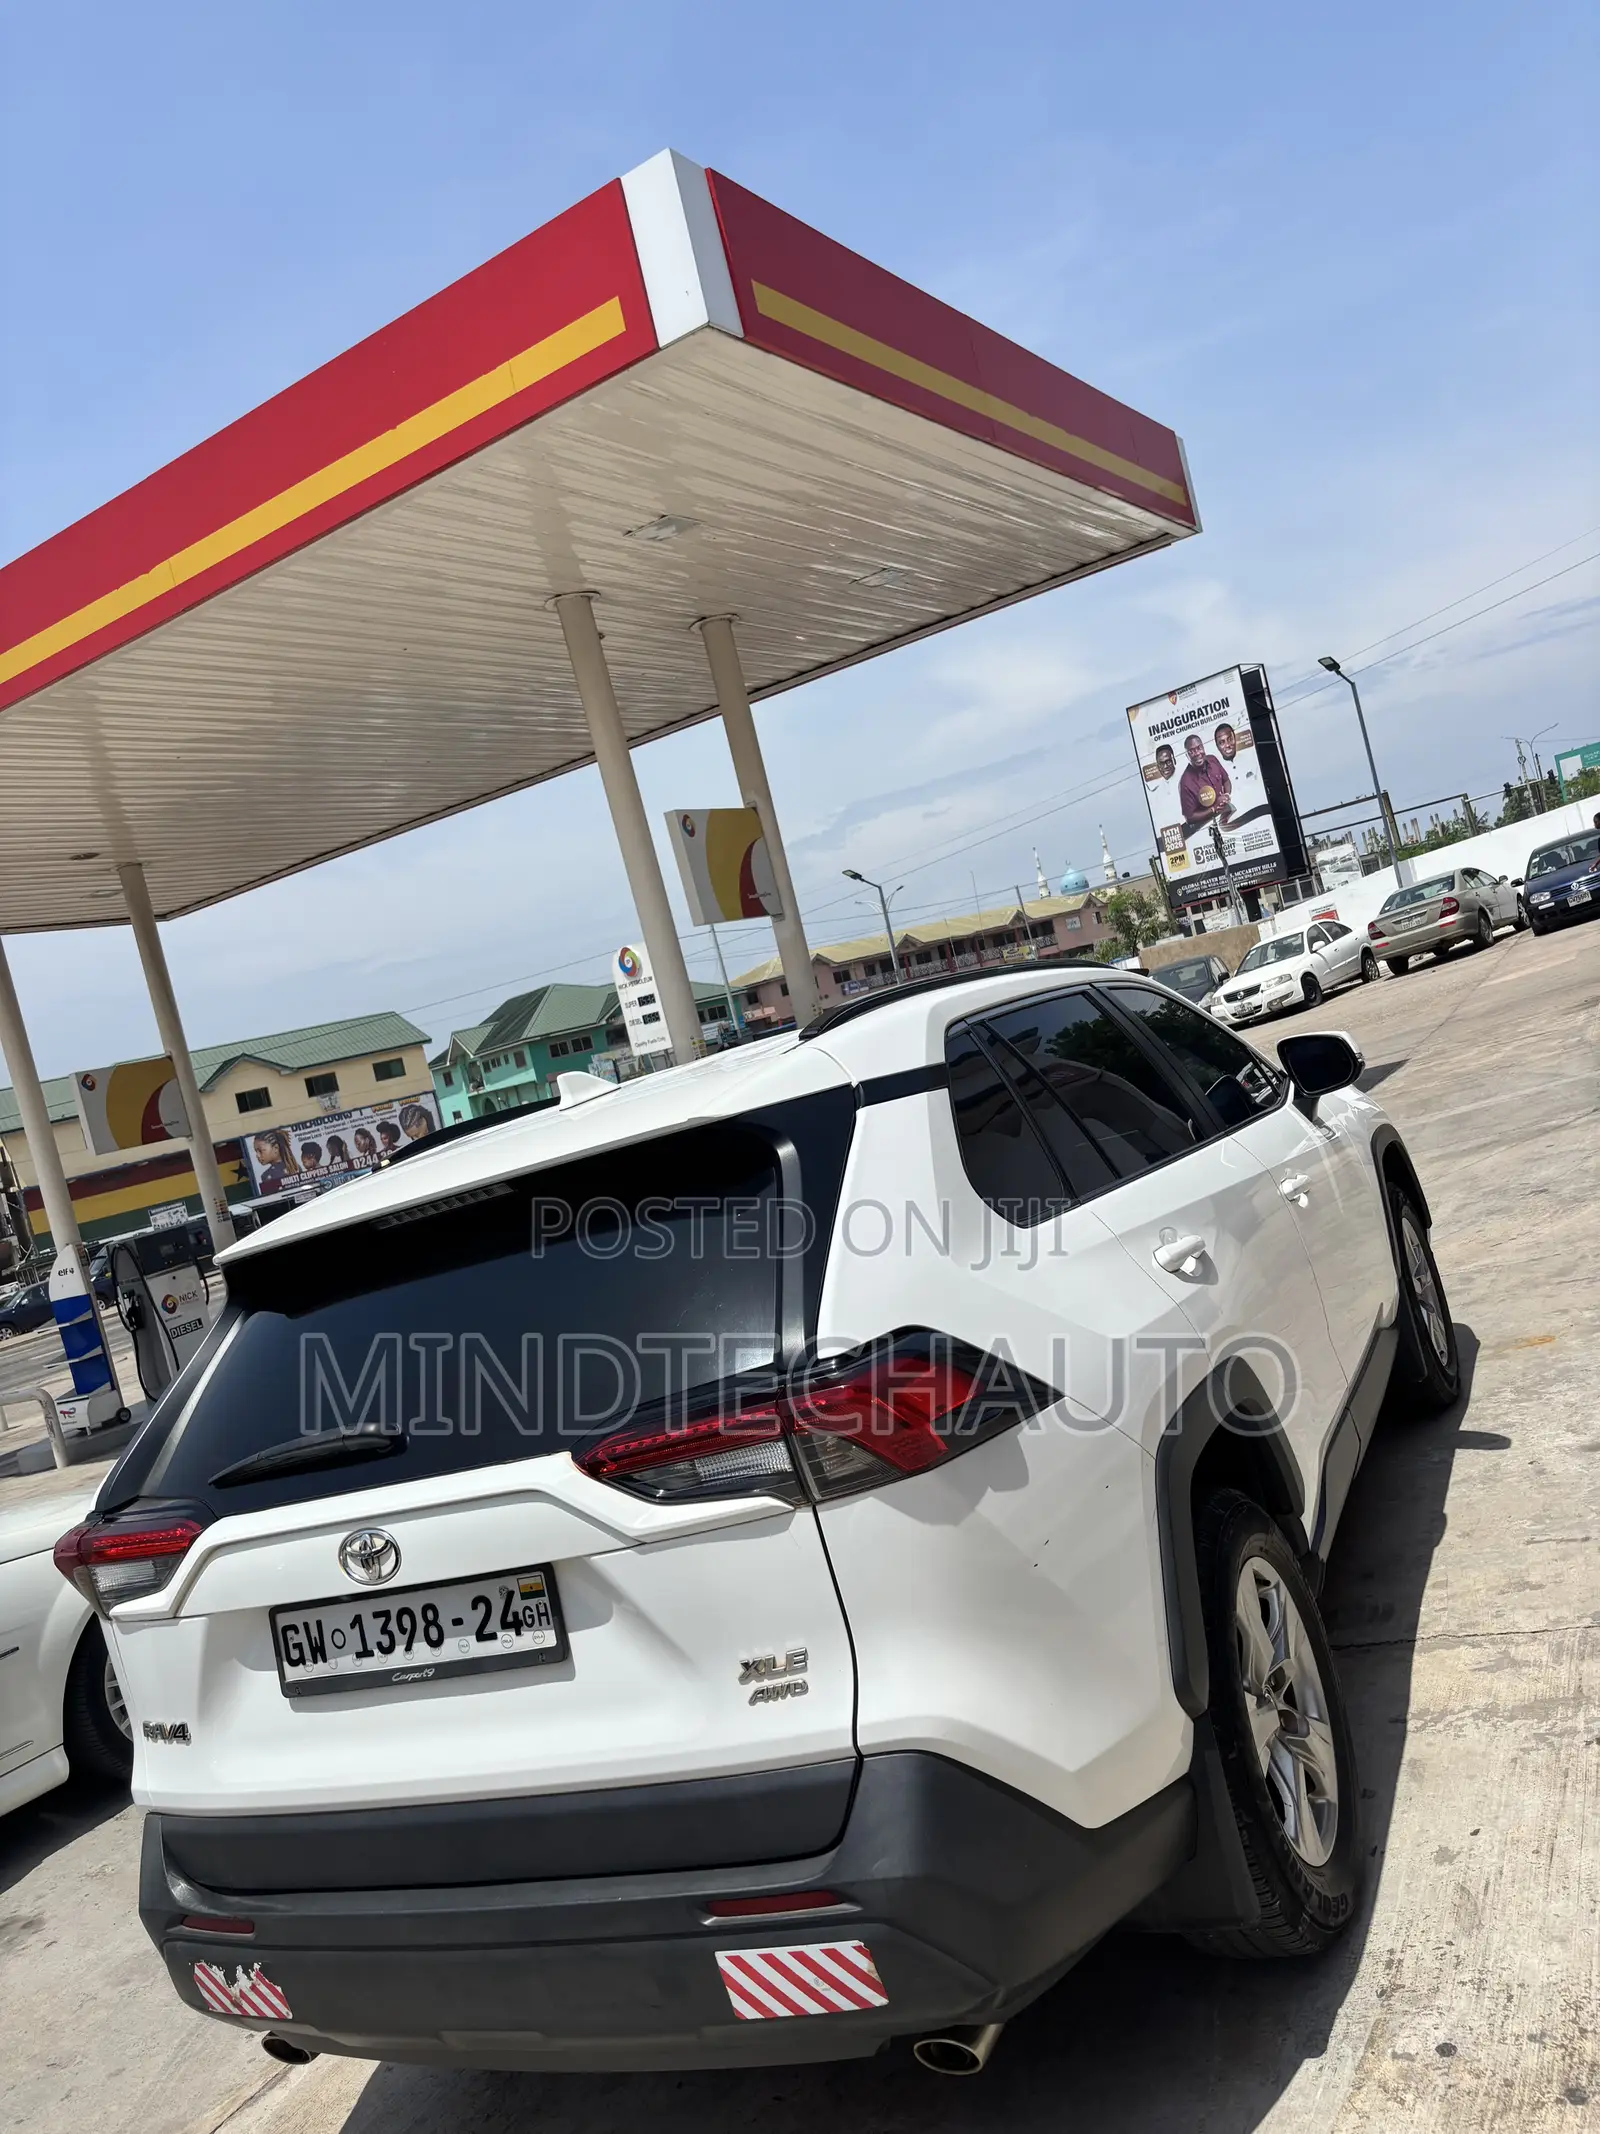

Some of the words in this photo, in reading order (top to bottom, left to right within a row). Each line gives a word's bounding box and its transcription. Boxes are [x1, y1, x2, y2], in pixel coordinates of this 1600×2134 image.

[1148, 697, 1230, 737] INAUGURATION
[1162, 730, 1175, 739] NEW
[1176, 721, 1200, 734] CHURCH
[1200, 710, 1228, 726] BUILDING
[1165, 835, 1181, 845] JUNE
[1166, 841, 1183, 852] 2026
[1170, 854, 1186, 864] 2PM
[1262, 862, 1277, 870] HILLS
[1207, 888, 1221, 896] MORE
[281, 1175, 299, 1185] MULTI
[300, 1167, 328, 1180] CLIPPERS
[328, 1162, 348, 1172] SALON
[352, 1154, 379, 1170] 0244
[58, 1268, 69, 1277] elf
[179, 1290, 198, 1303] NICK
[171, 1319, 203, 1338] DIESEL
[280, 1619, 328, 1668] GW
[523, 1602, 551, 1629] GH
[738, 1646, 808, 1685] XLE
[748, 1678, 809, 1706] AWD
[142, 1720, 192, 1746] RAV4
